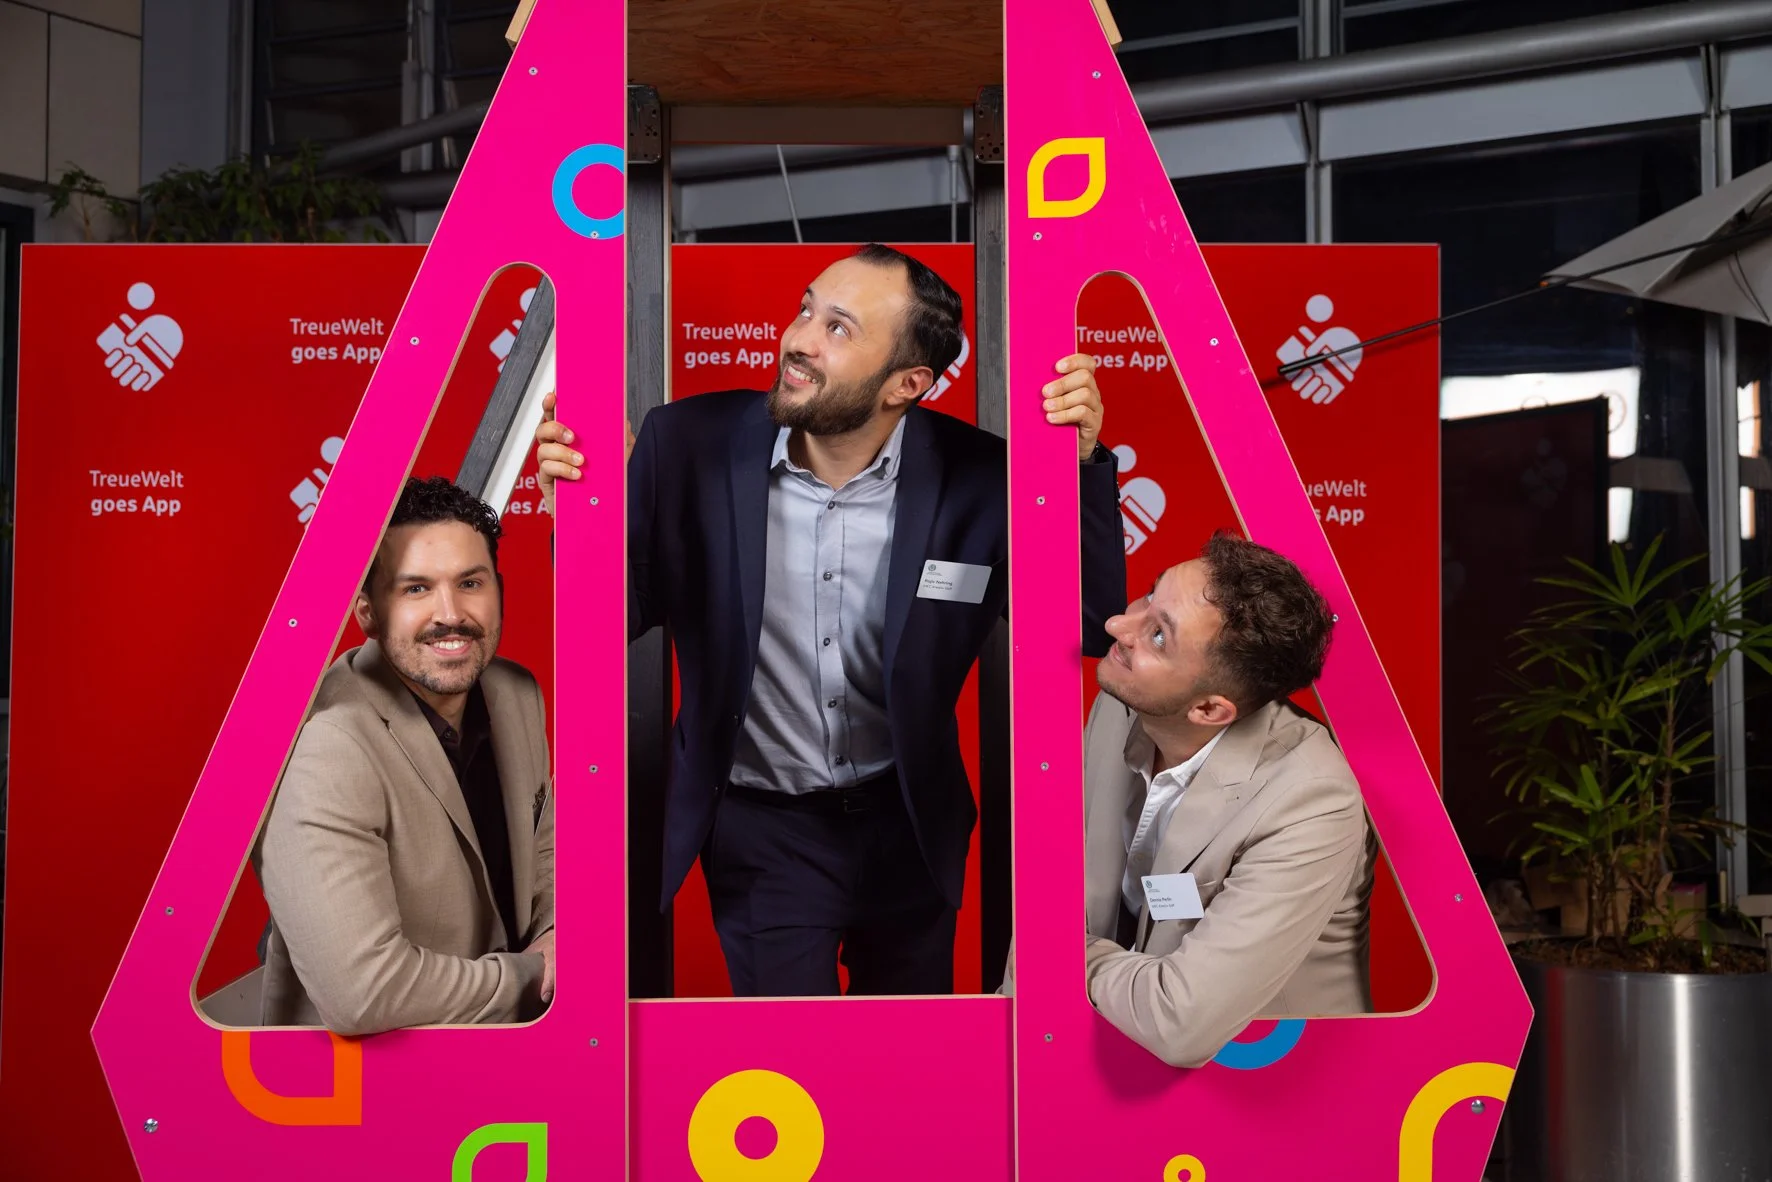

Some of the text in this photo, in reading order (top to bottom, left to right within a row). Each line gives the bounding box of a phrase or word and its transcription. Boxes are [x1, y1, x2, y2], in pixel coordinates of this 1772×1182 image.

[290, 317, 384, 335] TreueWelt
[682, 322, 777, 340] TreueWelt
[291, 343, 381, 364] goes App
[684, 348, 775, 369] goes App
[1093, 351, 1168, 372] oes App
[89, 469, 184, 488] TreueWelt
[91, 495, 181, 517] goes App
[1326, 505, 1365, 526] App
